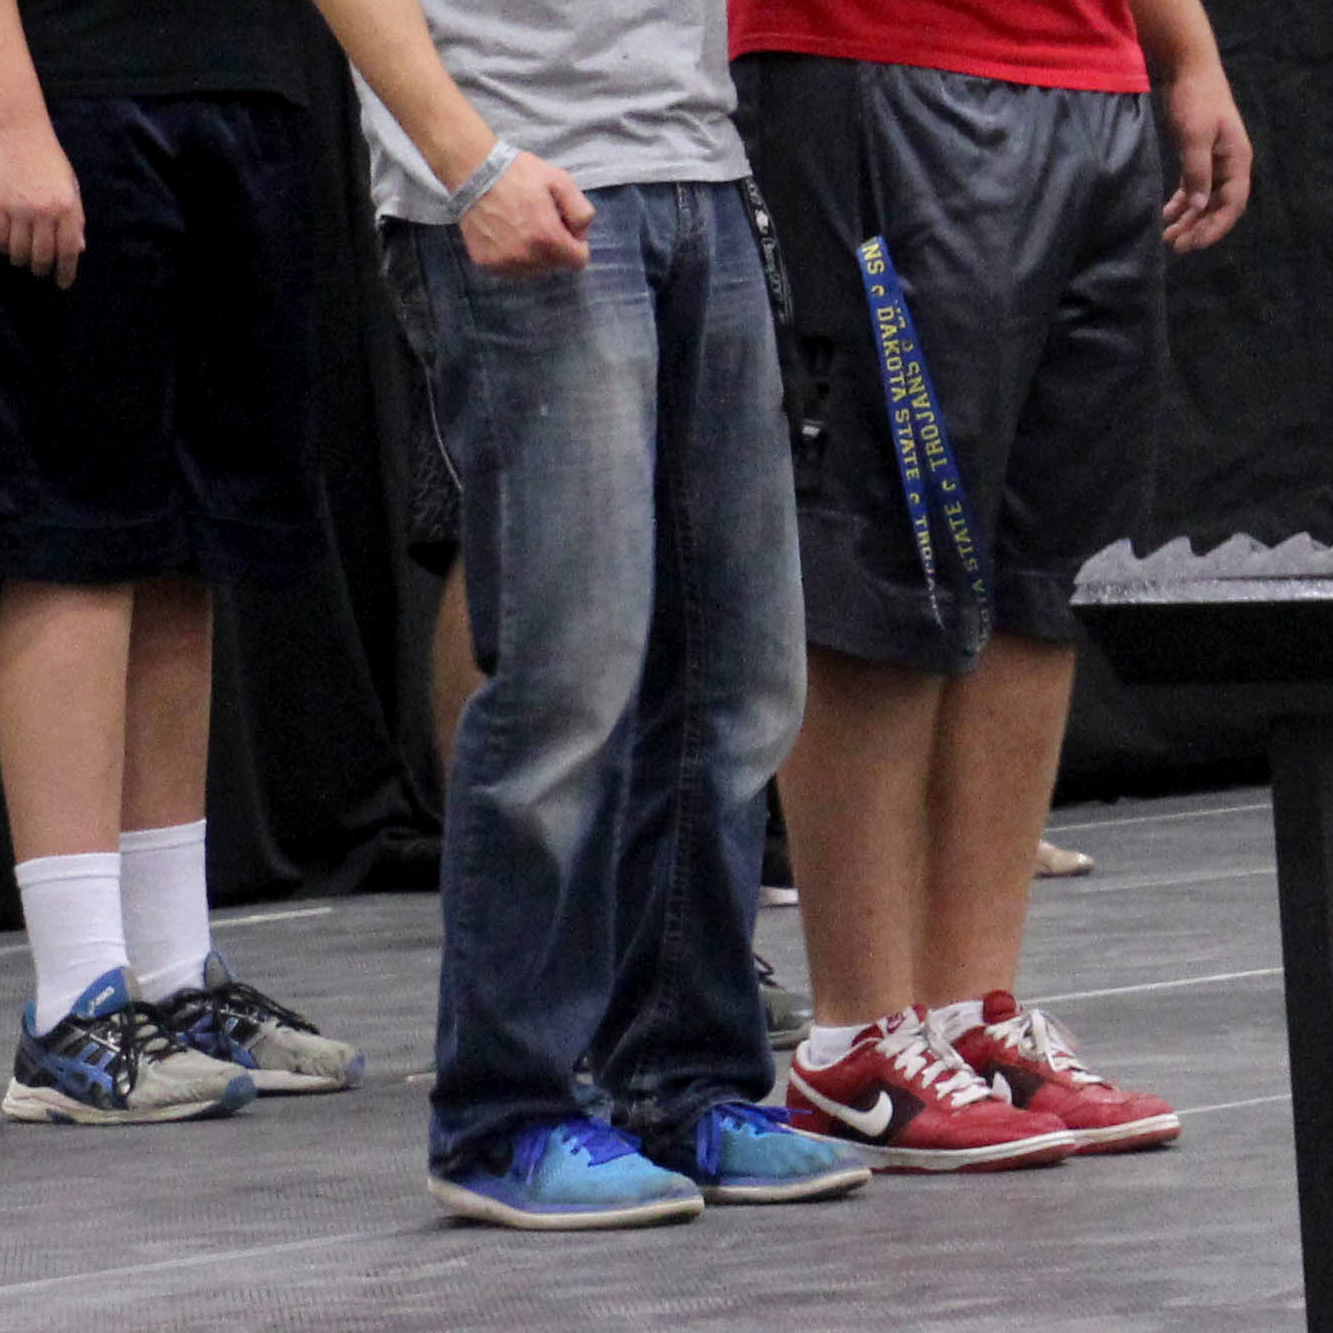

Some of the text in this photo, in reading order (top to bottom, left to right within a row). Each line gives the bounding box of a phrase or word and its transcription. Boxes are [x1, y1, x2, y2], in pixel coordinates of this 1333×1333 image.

[877, 305, 908, 403] DAKOTA
[895, 408, 921, 481] STATE
[943, 501, 978, 572] STATE
